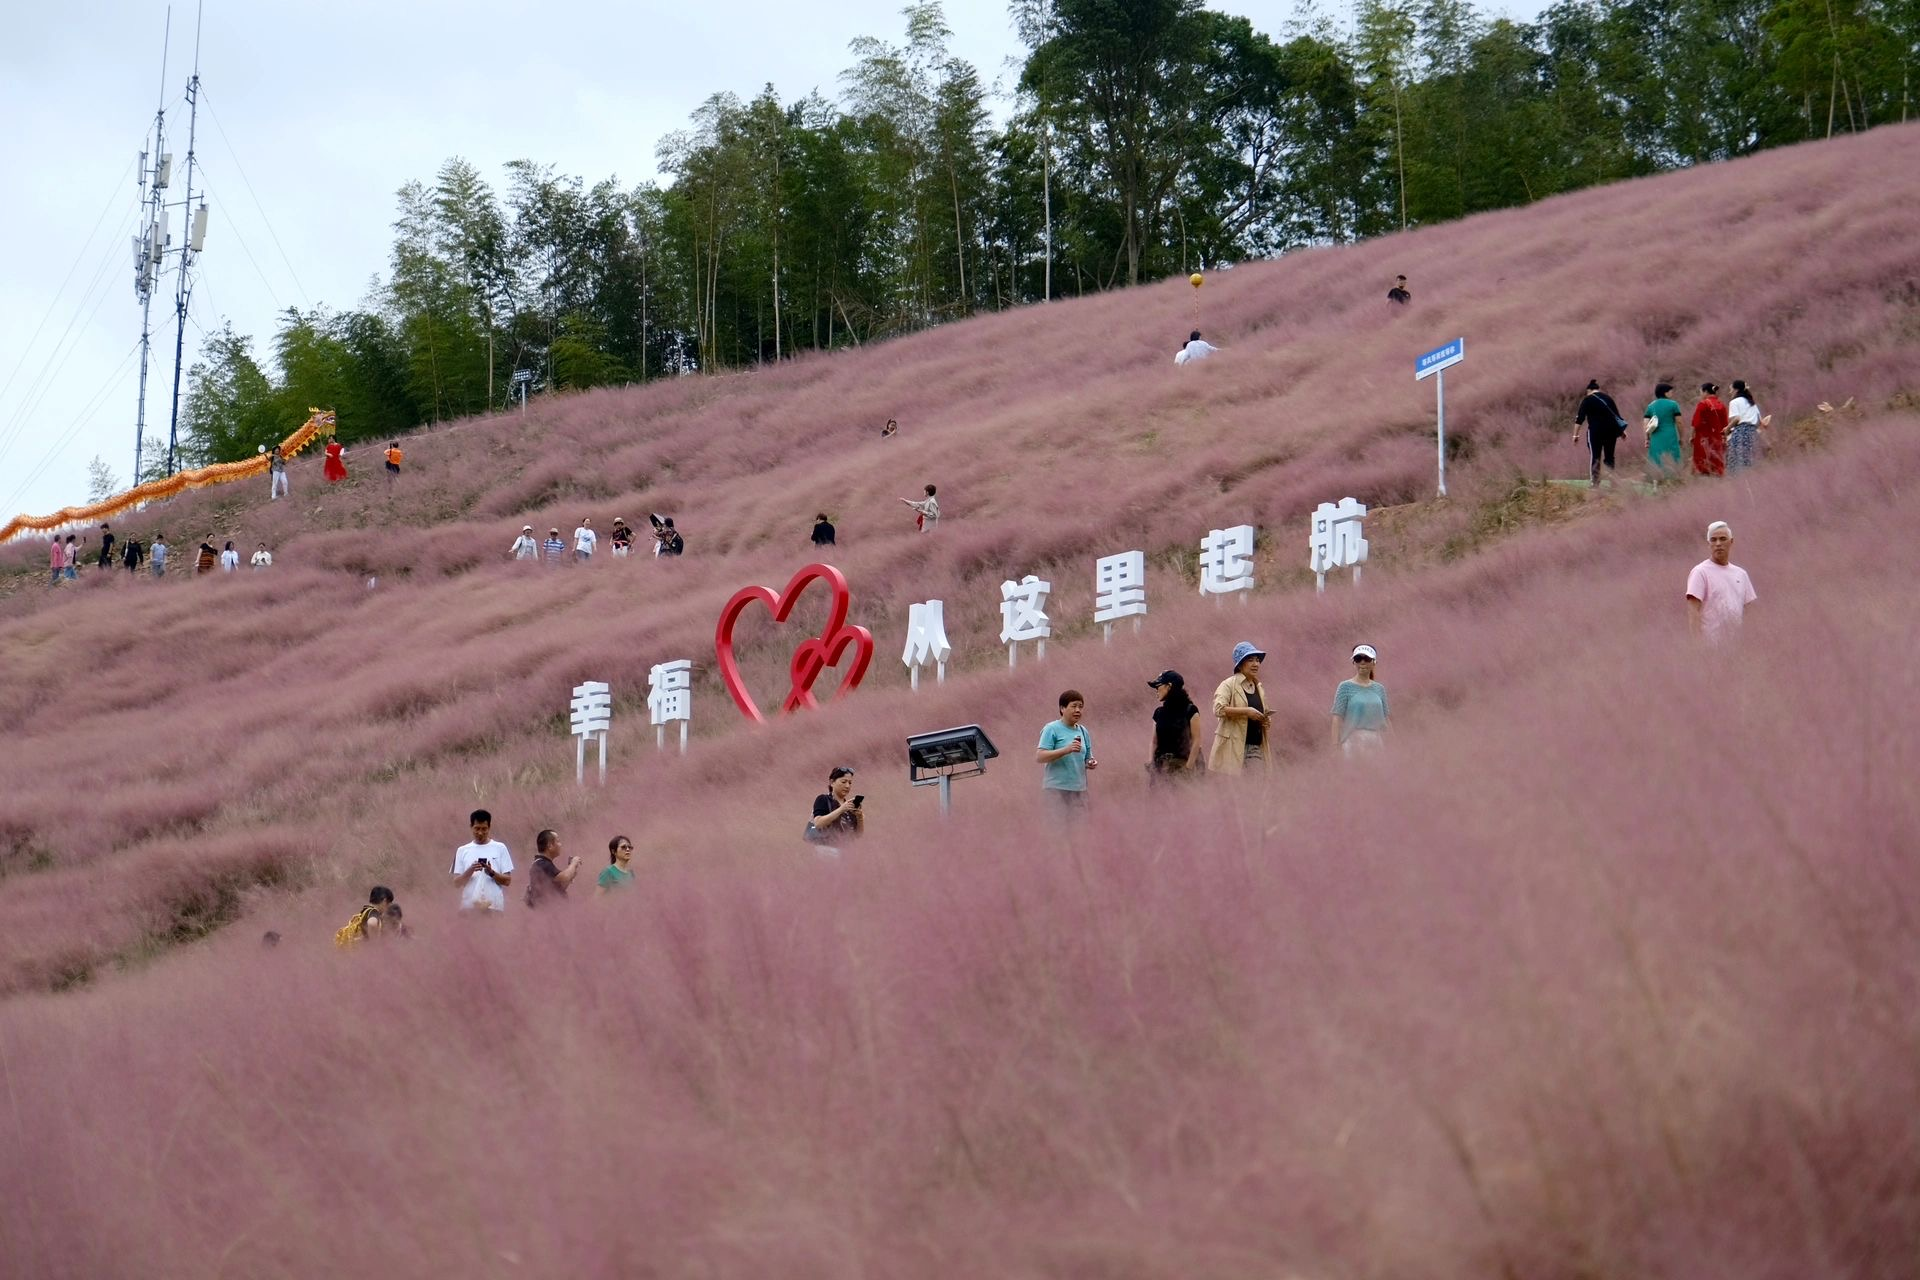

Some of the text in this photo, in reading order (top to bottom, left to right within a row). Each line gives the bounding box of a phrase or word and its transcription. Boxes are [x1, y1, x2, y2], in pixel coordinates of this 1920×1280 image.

[570, 497, 1368, 741] 幸福 从这里起航
